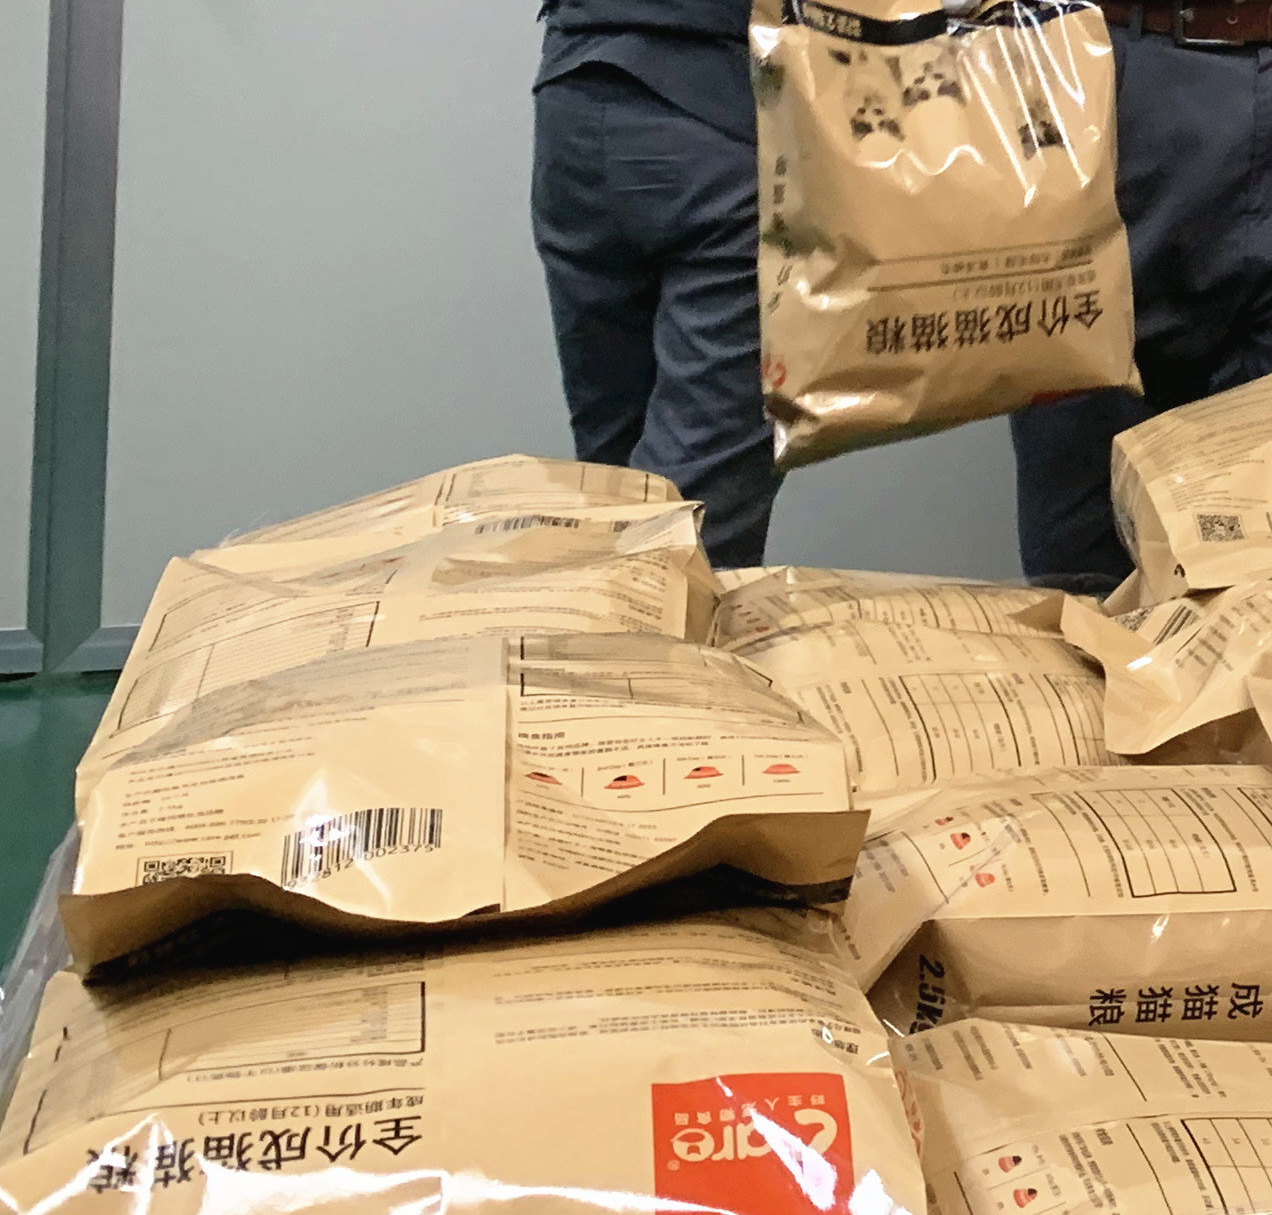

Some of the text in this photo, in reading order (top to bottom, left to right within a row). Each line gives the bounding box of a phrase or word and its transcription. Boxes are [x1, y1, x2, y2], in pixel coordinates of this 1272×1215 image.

[865, 290, 1104, 355] 全价成猫猫粮
